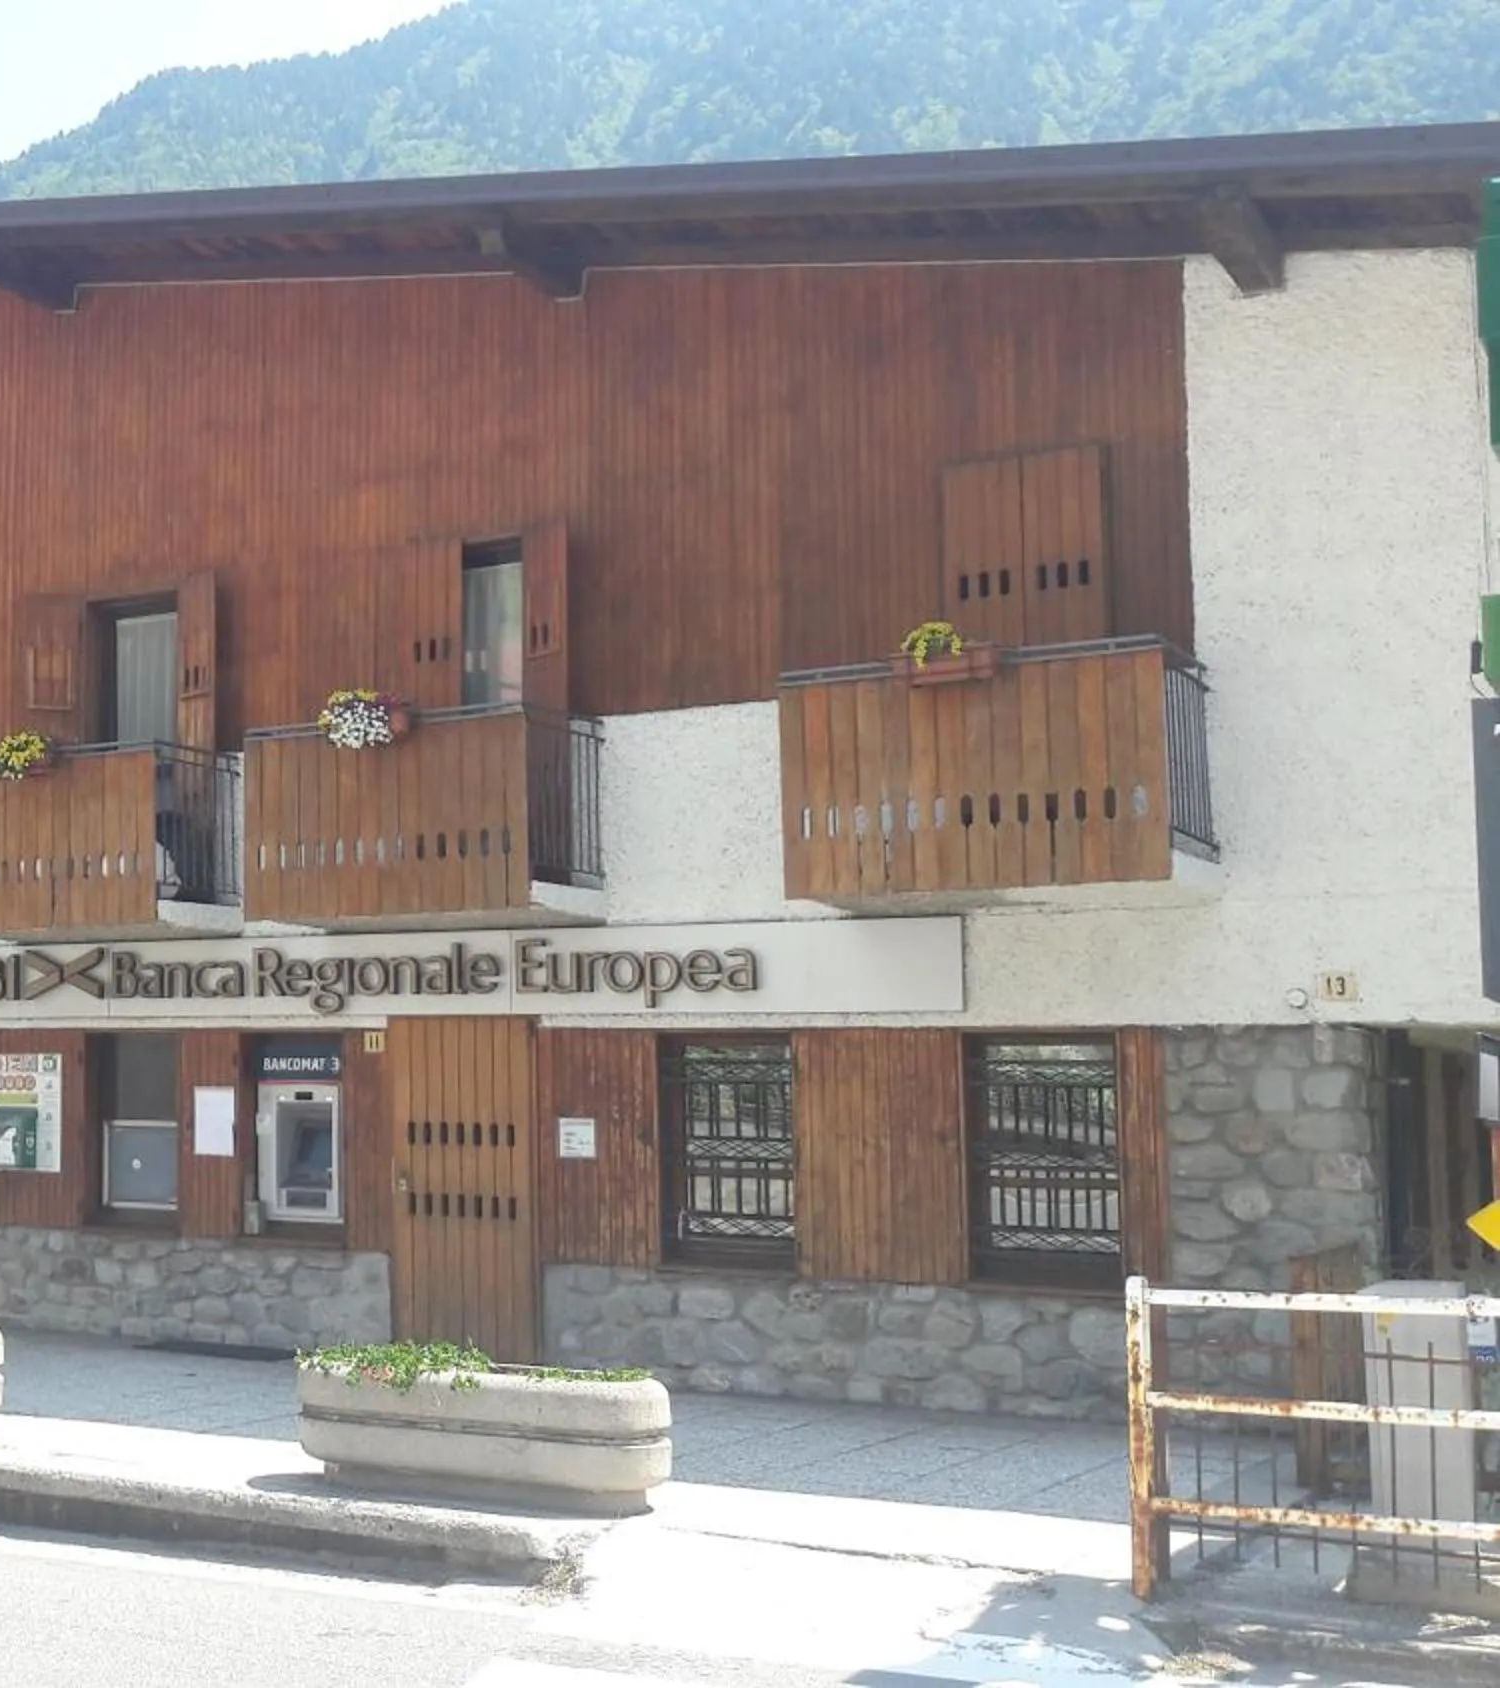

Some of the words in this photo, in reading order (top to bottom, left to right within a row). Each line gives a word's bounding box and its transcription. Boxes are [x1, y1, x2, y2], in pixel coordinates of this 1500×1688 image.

[112, 951, 246, 999] Banca
[252, 942, 501, 1014] Regionale
[516, 938, 759, 1009] Europea
[1326, 975, 1346, 996] 13
[263, 1057, 326, 1071] BANCOMAT
